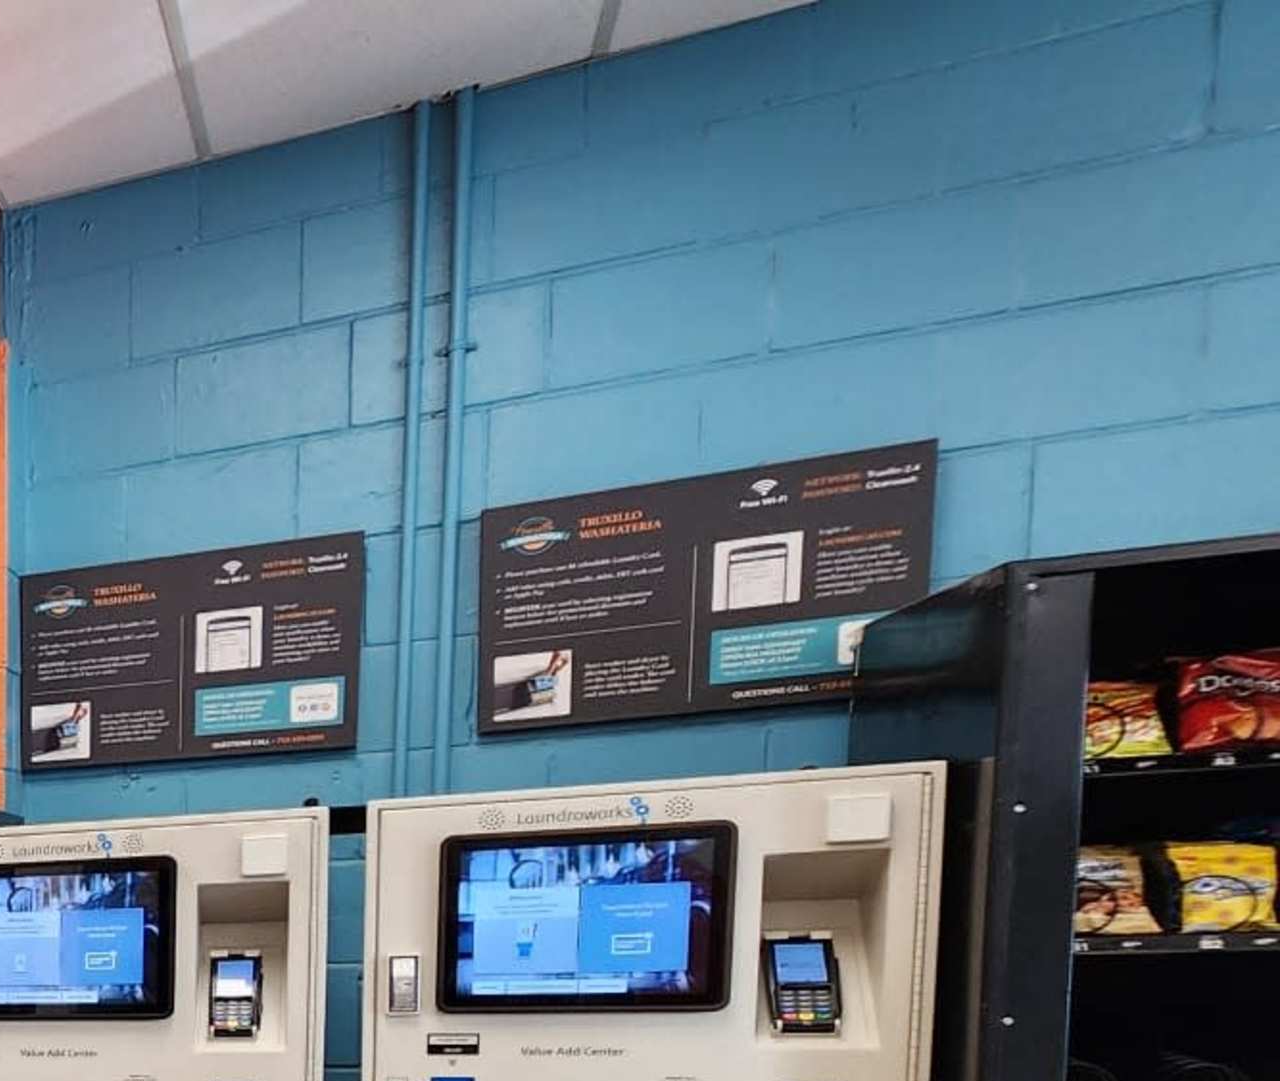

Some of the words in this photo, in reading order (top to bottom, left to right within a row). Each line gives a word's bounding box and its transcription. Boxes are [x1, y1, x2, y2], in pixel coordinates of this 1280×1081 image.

[579, 520, 663, 539] WASHATERIA
[516, 805, 633, 826] Laundroworks
[520, 1046, 552, 1057] Value
[556, 1046, 581, 1057] Add
[583, 1046, 625, 1057] Center
